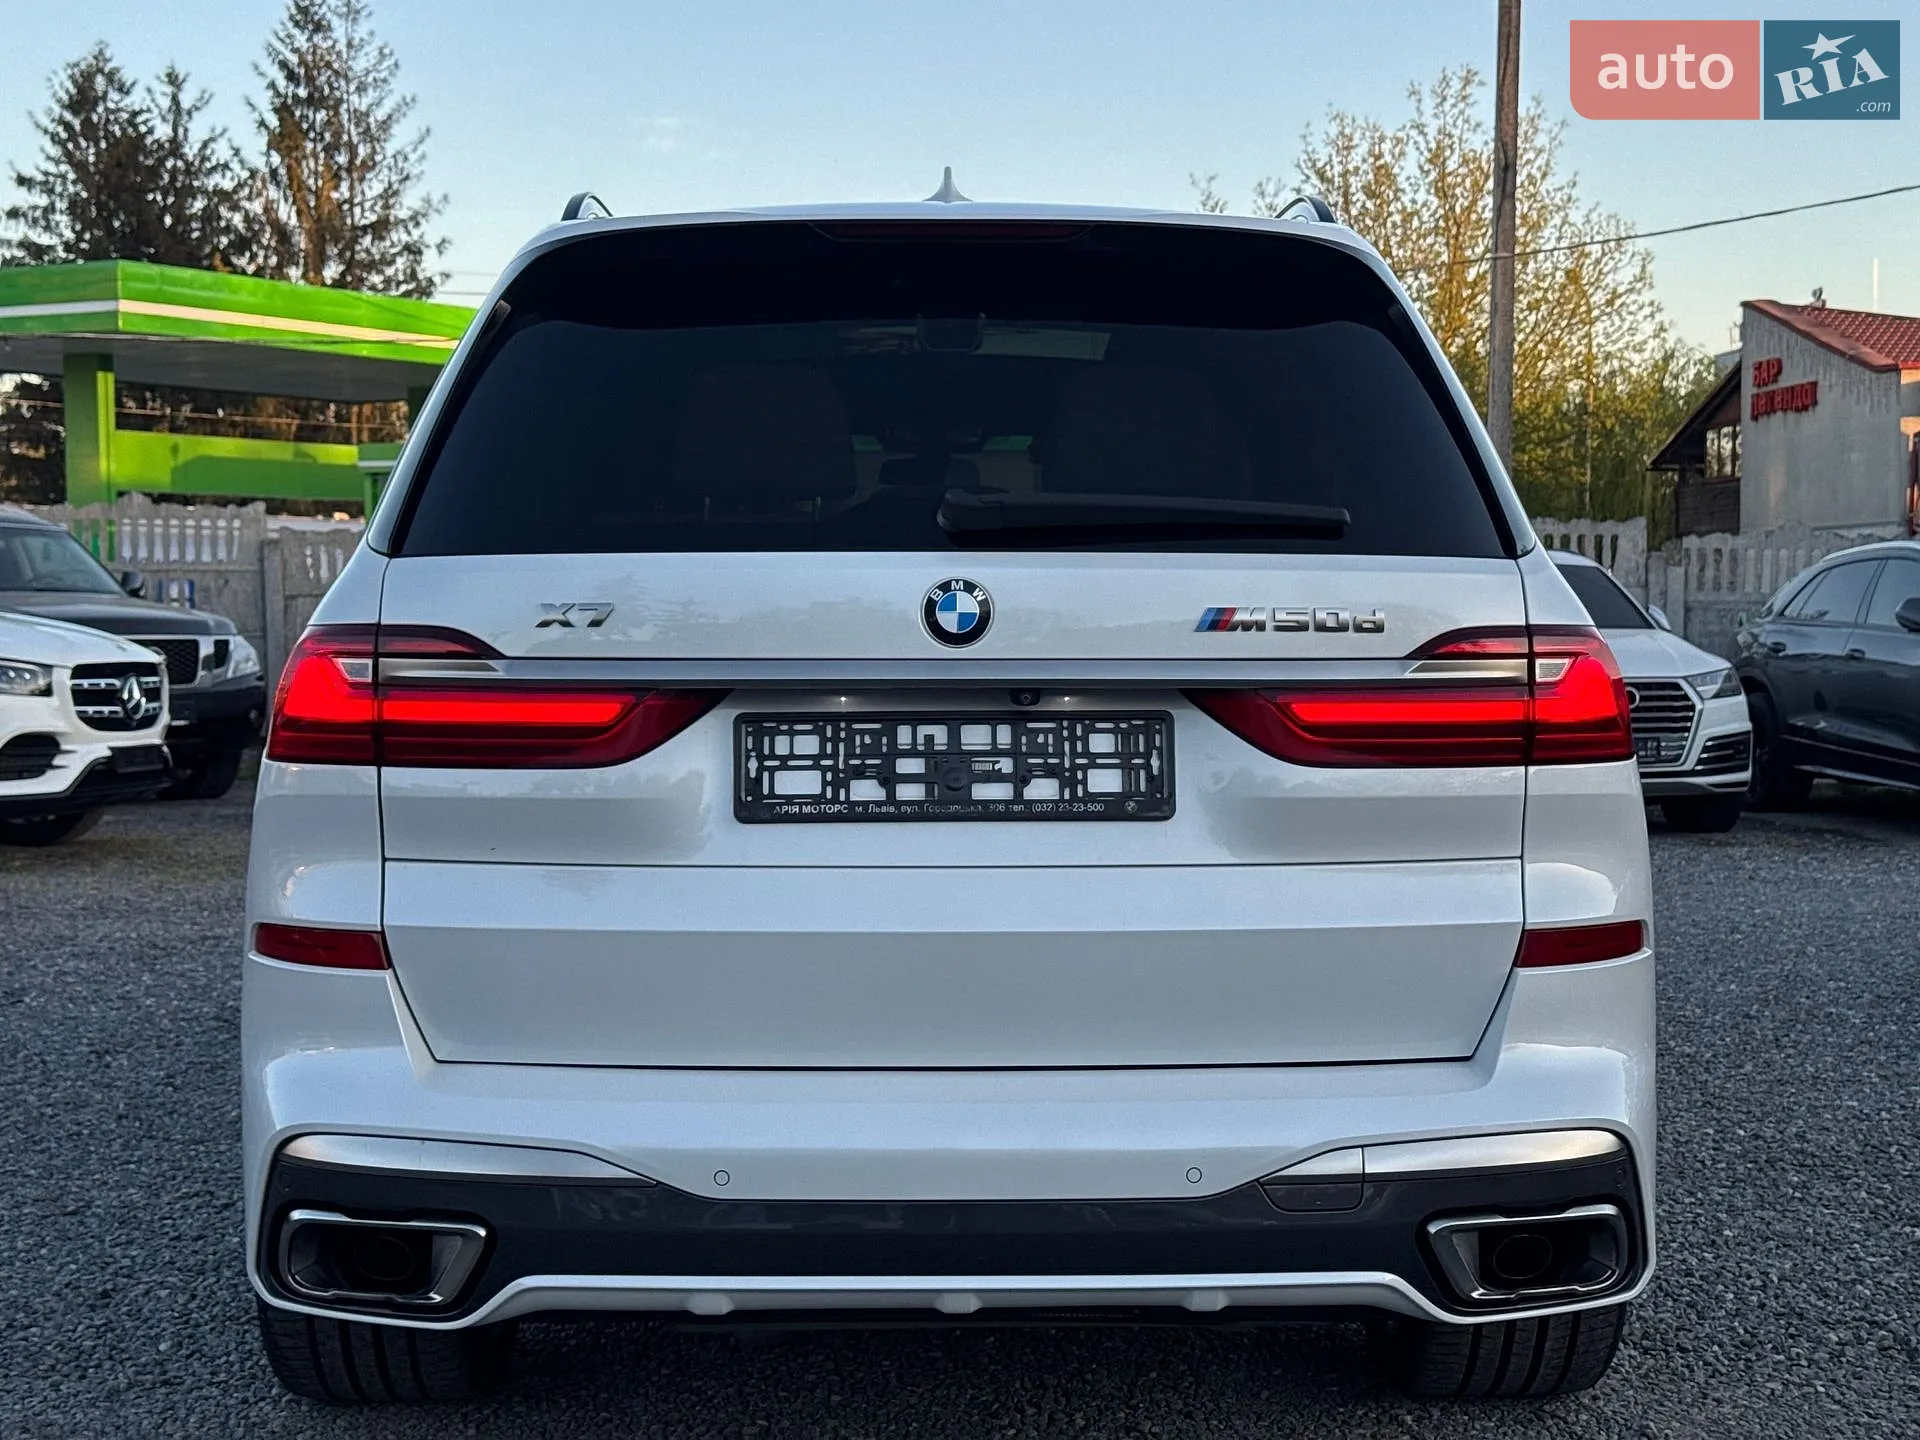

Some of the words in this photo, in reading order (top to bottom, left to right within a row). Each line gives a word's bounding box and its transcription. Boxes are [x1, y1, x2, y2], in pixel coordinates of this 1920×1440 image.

[1752, 357, 1783, 388] БАР
[930, 580, 986, 602] BMW
[535, 602, 614, 628] X7
[1222, 606, 1385, 633] M50d
[802, 803, 849, 813] МОТОРС
[1032, 802, 1056, 813] (032)
